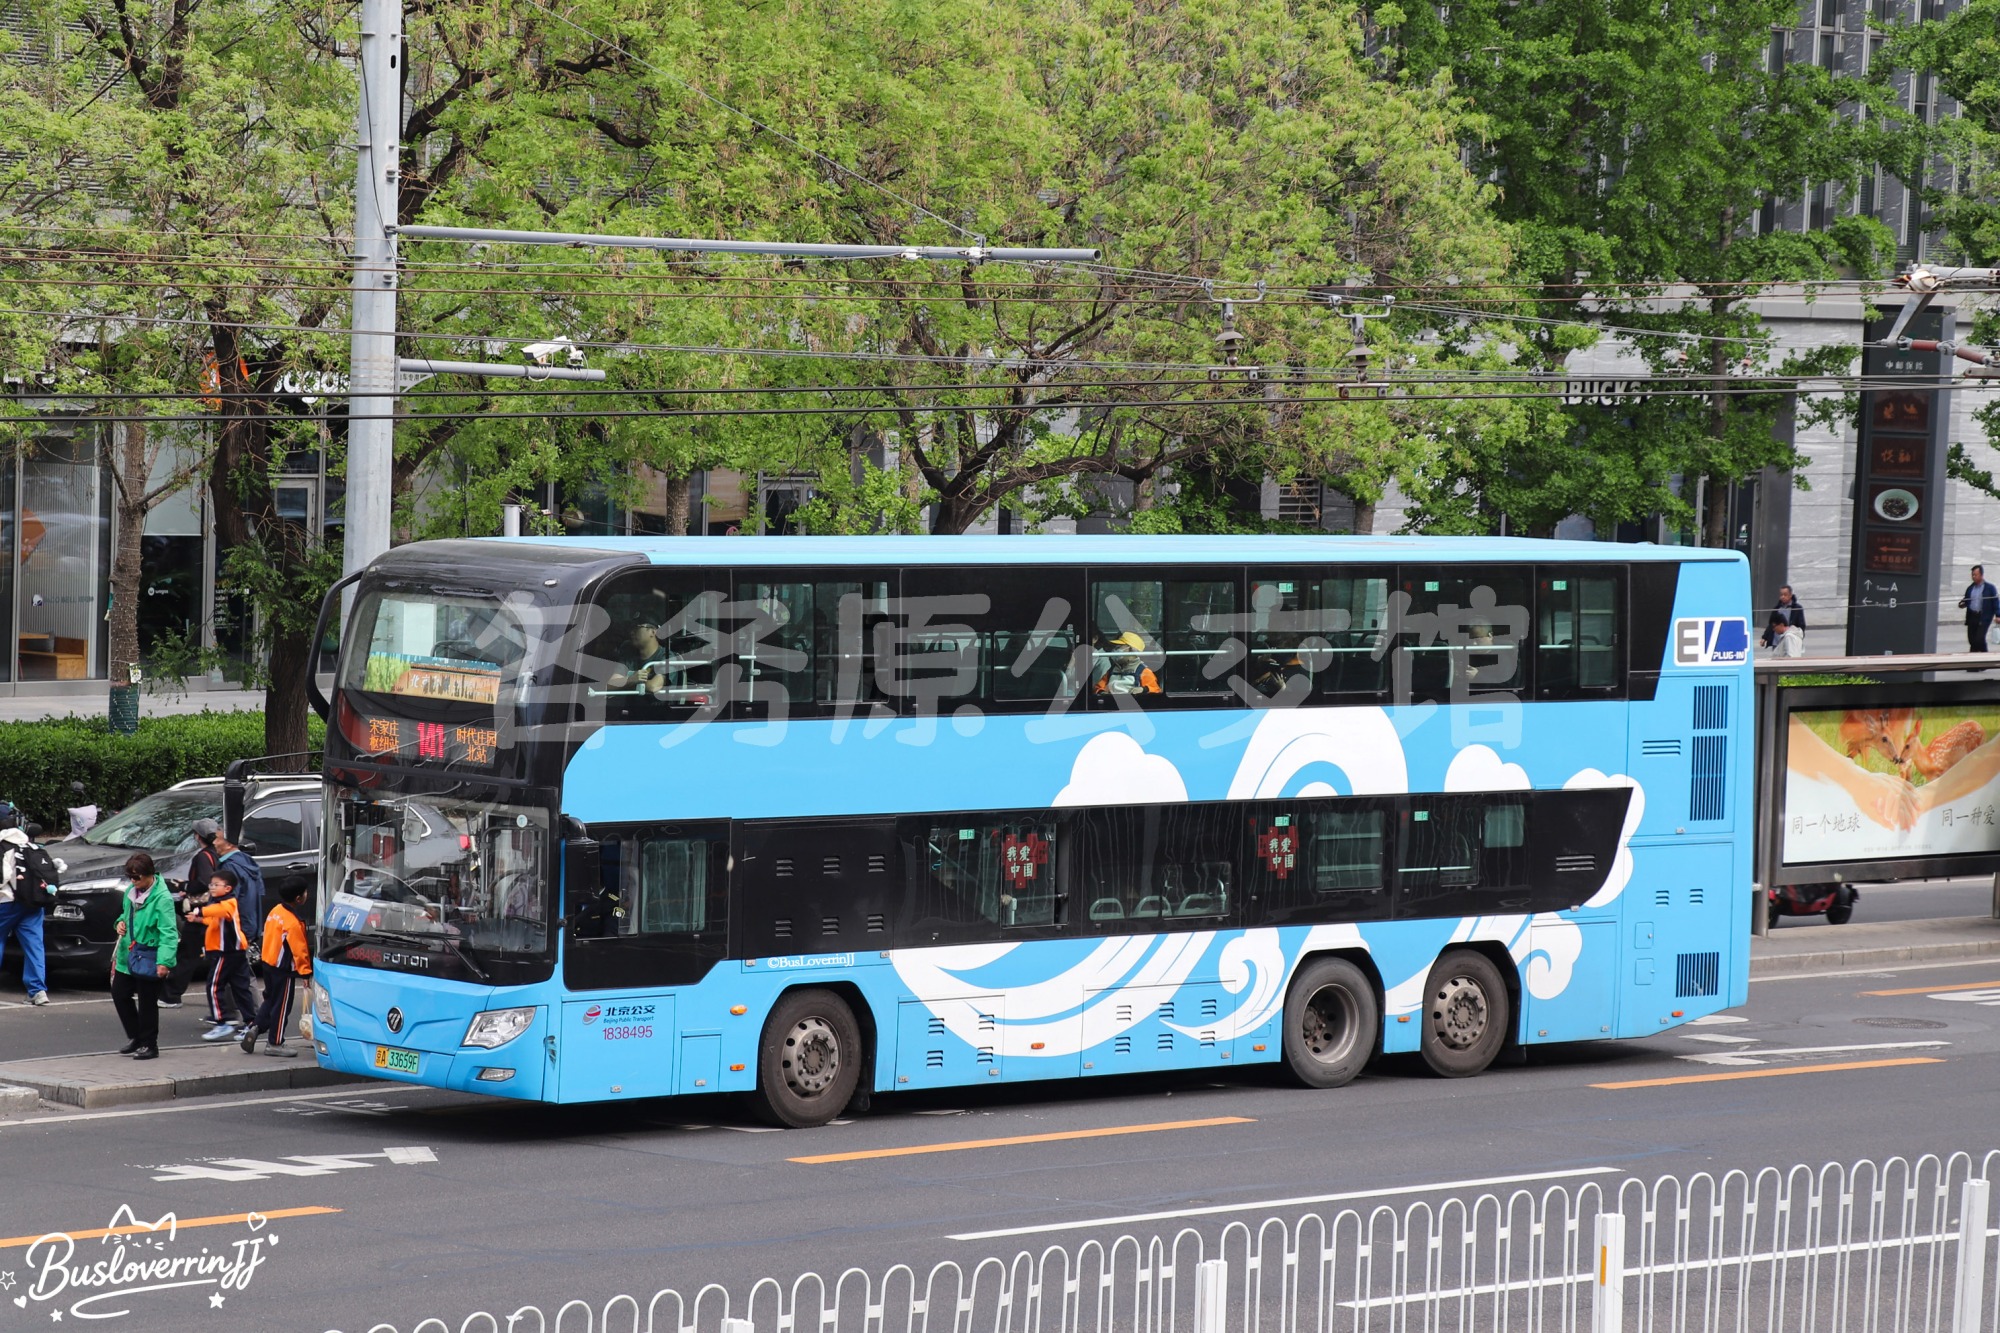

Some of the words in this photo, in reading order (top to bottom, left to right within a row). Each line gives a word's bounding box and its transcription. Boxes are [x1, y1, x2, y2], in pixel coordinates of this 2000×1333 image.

[1890, 582, 1898, 592] A
[1889, 598, 1897, 609] B
[1712, 650, 1745, 660] PLUG-IN
[369, 718, 400, 737] 宋家庄
[416, 721, 445, 758] 141
[456, 727, 498, 748] 时代庄园
[465, 745, 487, 764] 北站
[1791, 812, 1861, 835] 同一个地球
[1941, 804, 1996, 827] 同一种爱
[383, 952, 429, 968] FOTON
[604, 1004, 656, 1016] 北京公交
[602, 1025, 653, 1040] 1838495
